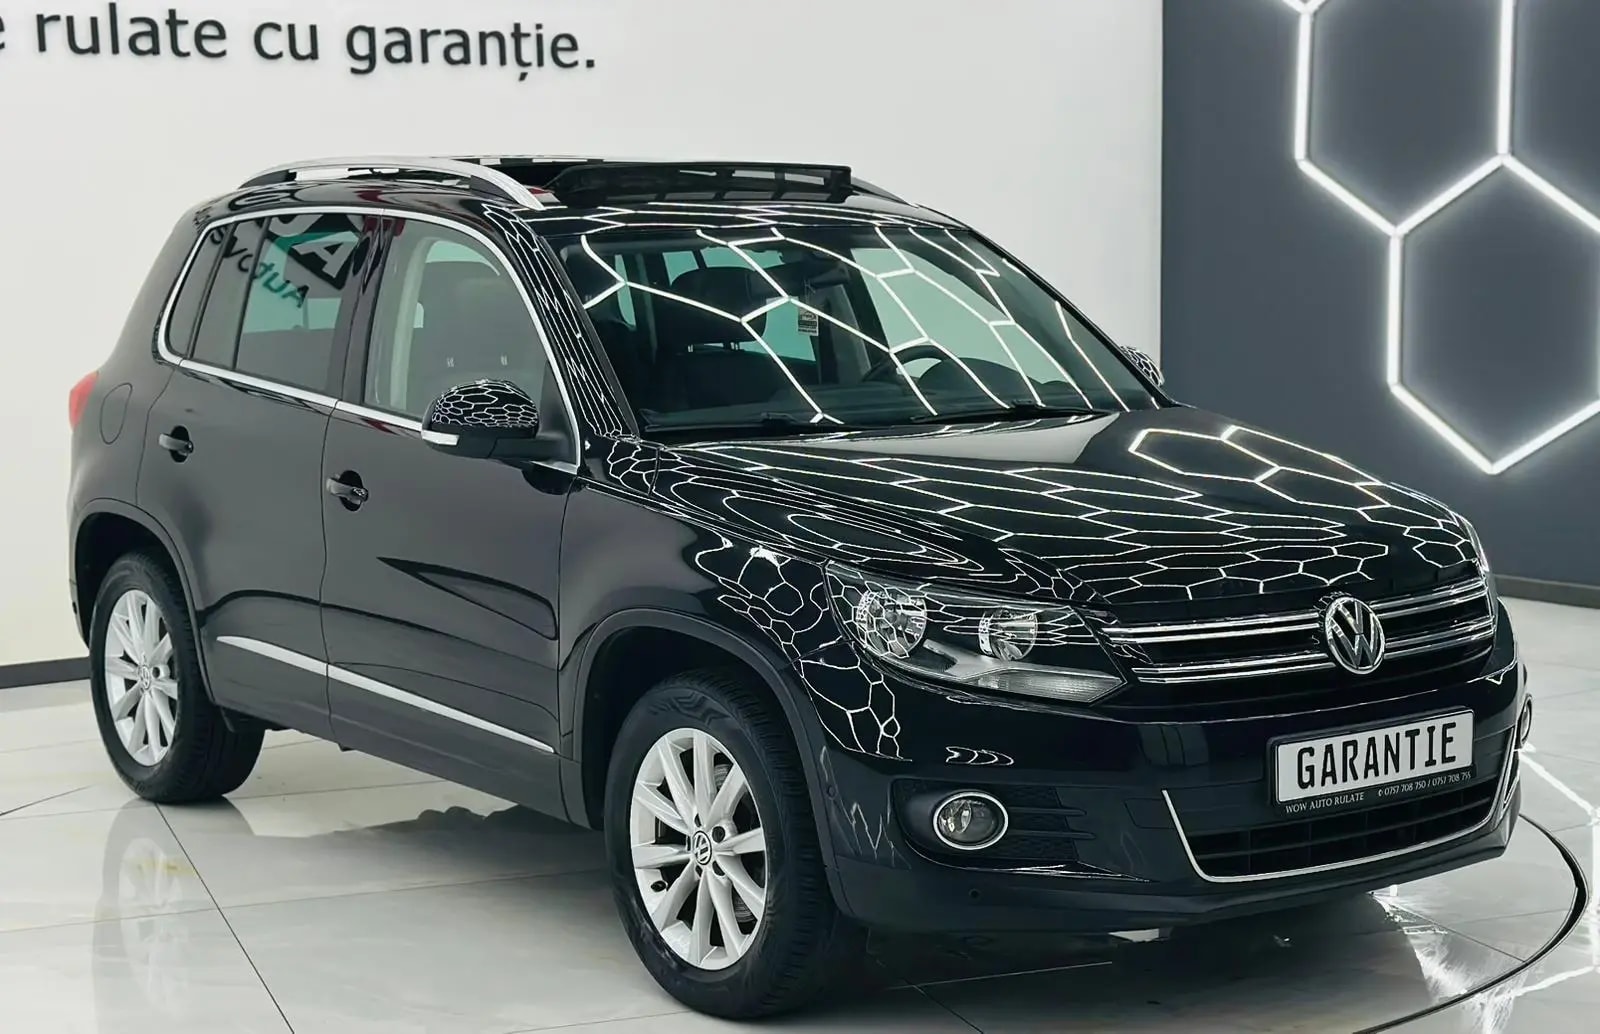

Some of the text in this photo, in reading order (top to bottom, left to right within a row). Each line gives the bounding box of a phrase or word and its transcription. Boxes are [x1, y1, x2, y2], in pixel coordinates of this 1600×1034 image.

[36, 3, 227, 59] rulate
[253, 22, 319, 62] cu
[345, 23, 595, 83] garanție.
[1298, 722, 1456, 789] GARANTIE
[1285, 803, 1308, 813] WOW
[1310, 798, 1333, 810] AUTO
[1335, 791, 1365, 805] RULATE
[1384, 786, 1399, 796] 0757
